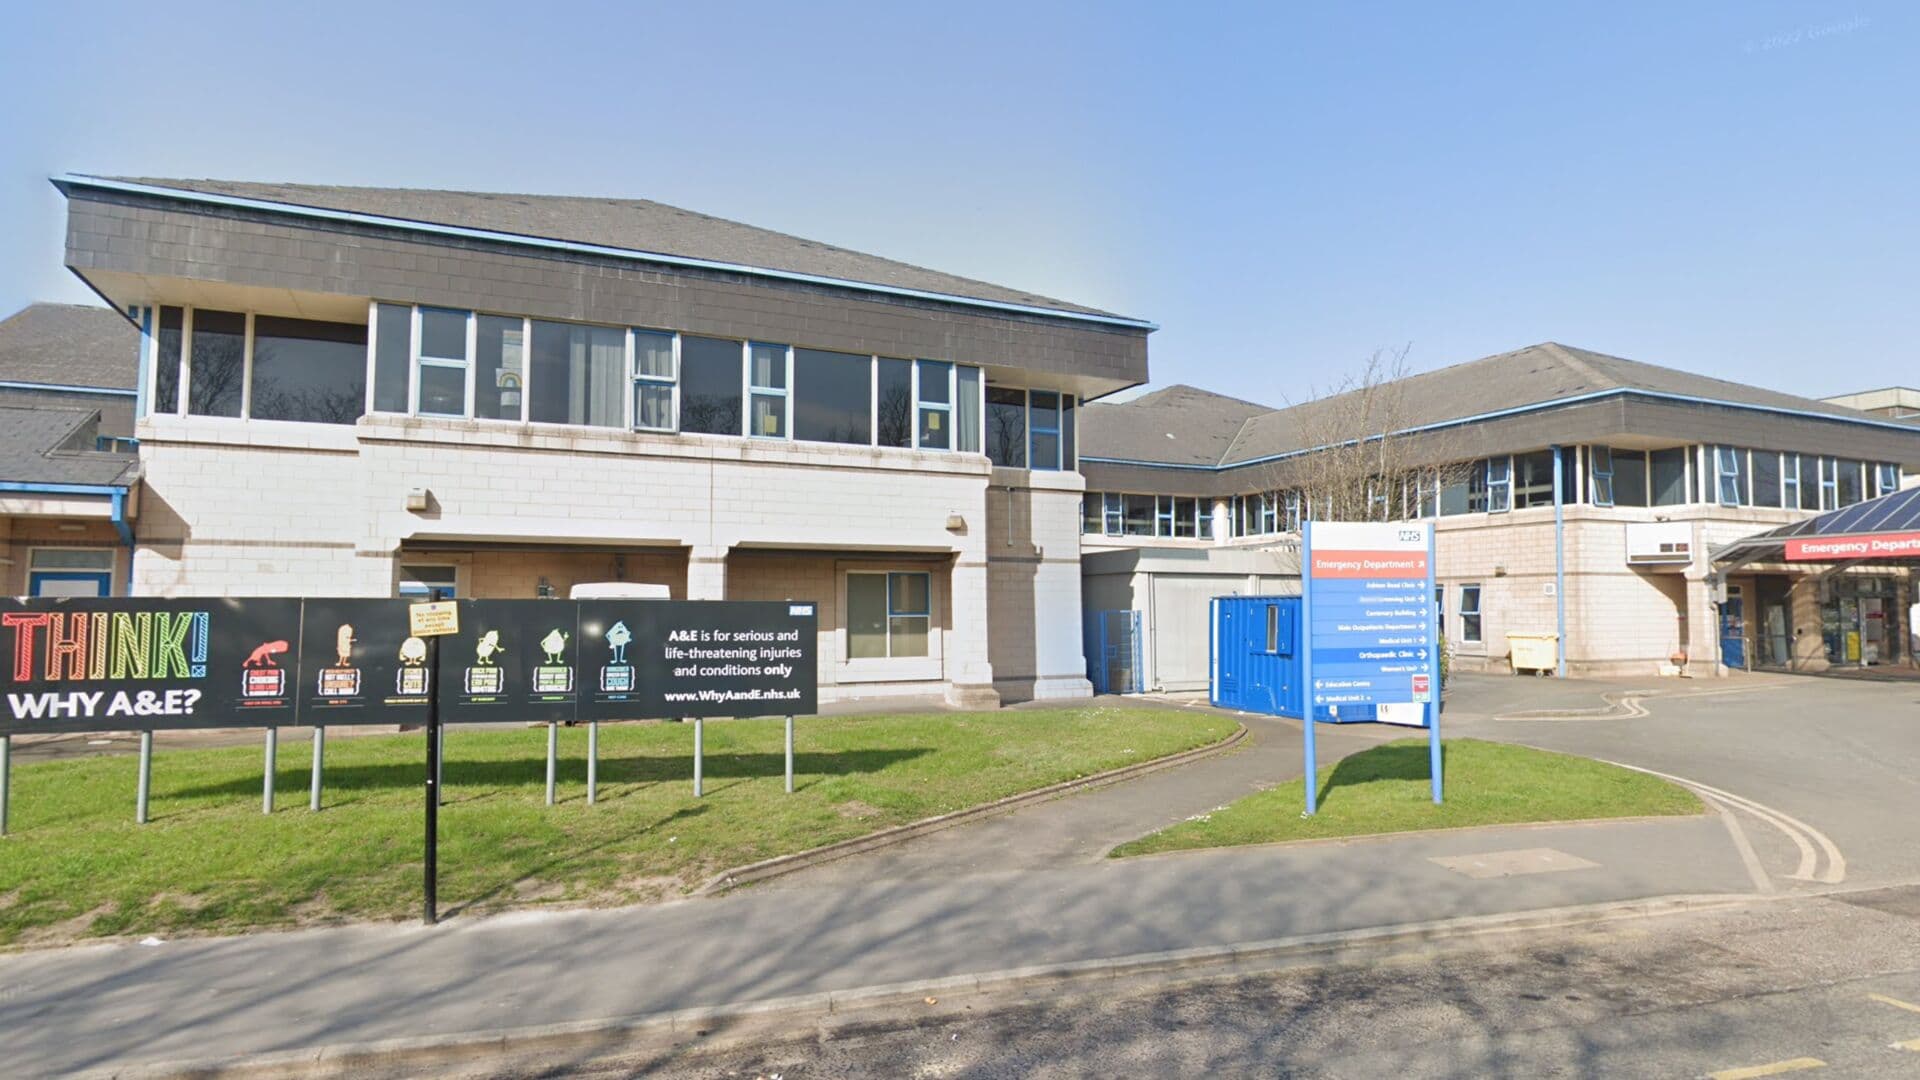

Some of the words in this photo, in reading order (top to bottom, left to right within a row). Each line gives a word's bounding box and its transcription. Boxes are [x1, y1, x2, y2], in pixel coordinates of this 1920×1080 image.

[1399, 530, 1421, 542] NHS
[1801, 542, 1868, 554] Emergency
[1316, 560, 1362, 572] Emergency
[1363, 560, 1415, 571] Department
[668, 630, 698, 642] A&E
[701, 630, 710, 642] is
[713, 629, 731, 641] for
[733, 630, 774, 642] serious
[777, 629, 799, 641] and
[2, 612, 209, 681] THINK!
[664, 646, 758, 662] life-threatening
[760, 647, 802, 661] injuries
[674, 664, 697, 677] and
[700, 664, 761, 677] conditions
[763, 663, 793, 678] only
[7, 692, 104, 719] WHY
[106, 688, 202, 717] A&E?
[665, 688, 801, 704] www.WhyAandE.nhs.uk
